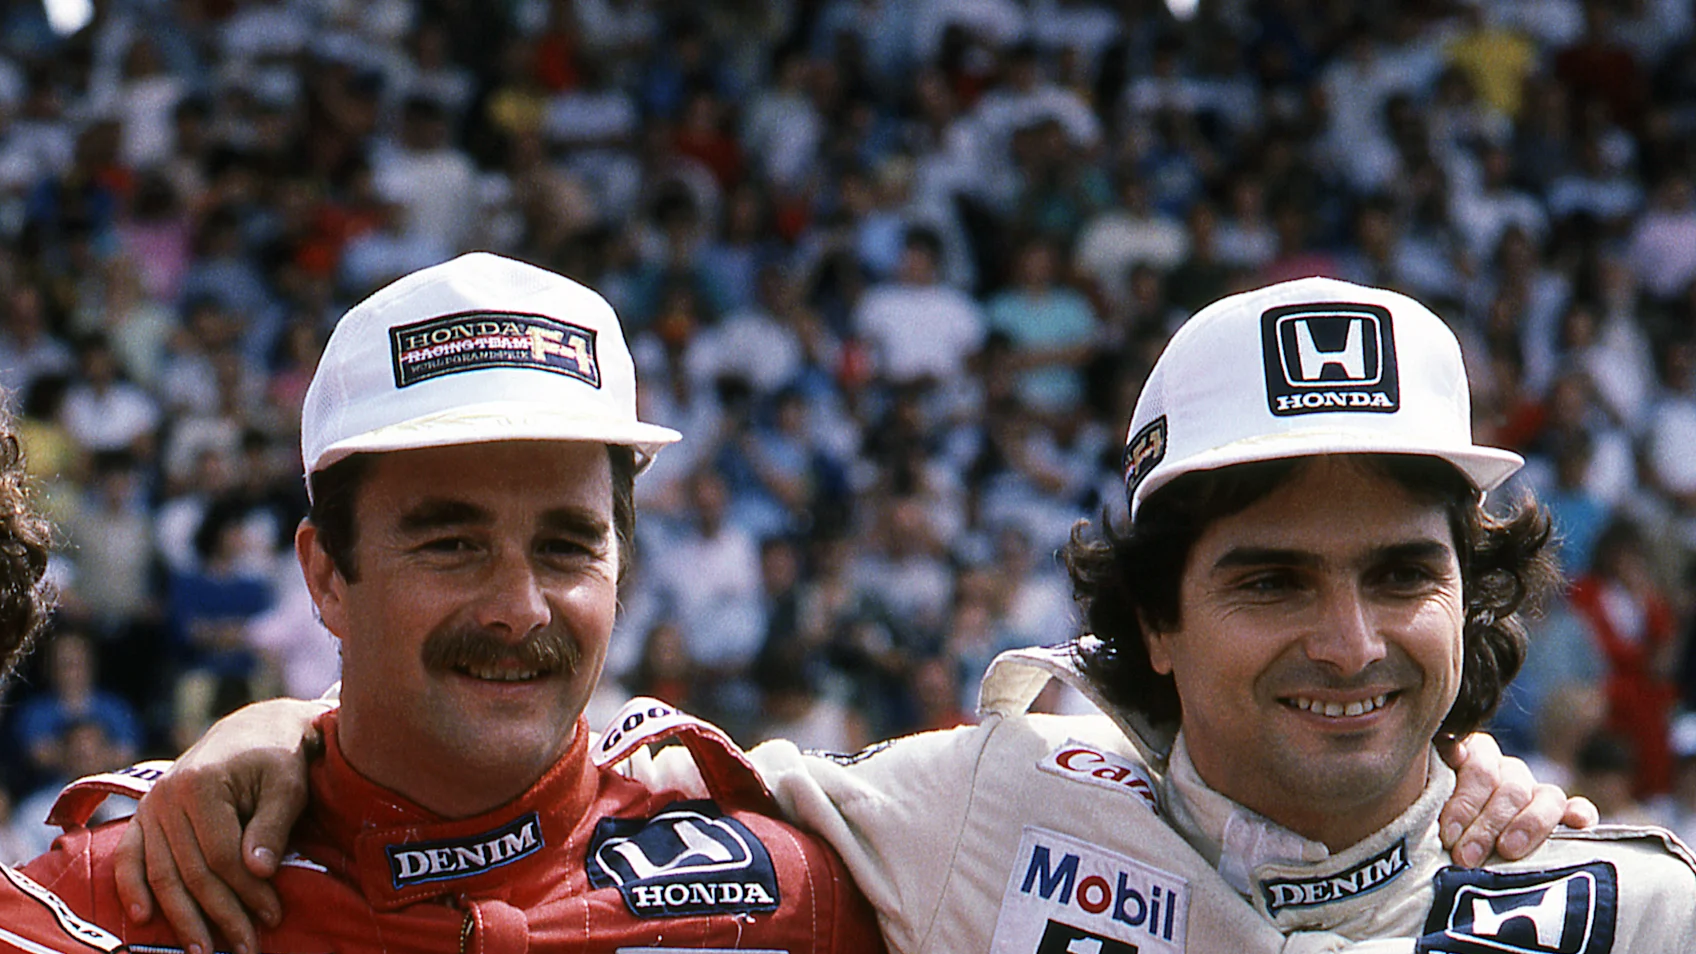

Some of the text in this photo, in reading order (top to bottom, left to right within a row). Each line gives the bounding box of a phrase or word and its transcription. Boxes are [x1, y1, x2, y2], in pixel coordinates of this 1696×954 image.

[406, 322, 520, 349] HONDA
[1276, 392, 1394, 411] HONDA
[602, 708, 680, 752] GOO
[1056, 749, 1156, 812] Can
[394, 821, 537, 880] DENIM
[631, 884, 774, 909] HONDA
[1021, 845, 1176, 941] Mobil
[1267, 850, 1406, 908] DENIM
